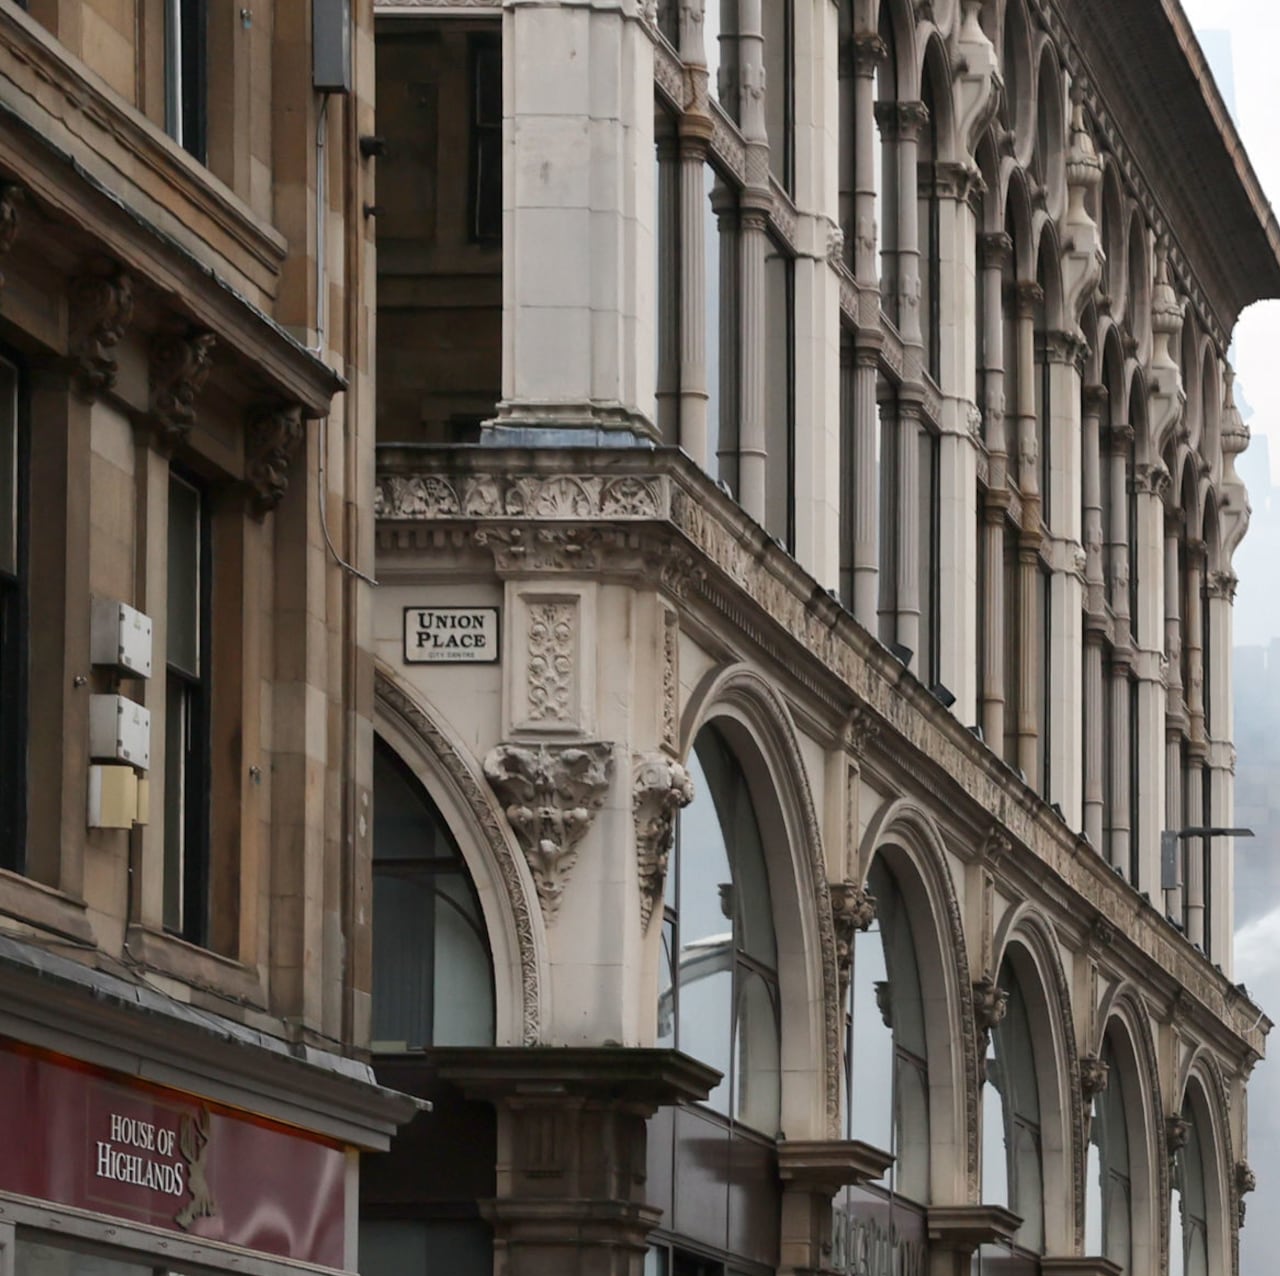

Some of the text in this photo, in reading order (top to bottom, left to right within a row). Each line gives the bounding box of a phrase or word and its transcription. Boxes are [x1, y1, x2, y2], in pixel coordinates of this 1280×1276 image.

[418, 613, 484, 629] UNION
[416, 631, 486, 648] PLACE
[110, 1113, 176, 1157] HOUSE OF
[96, 1141, 184, 1197] HIGHLANDS
